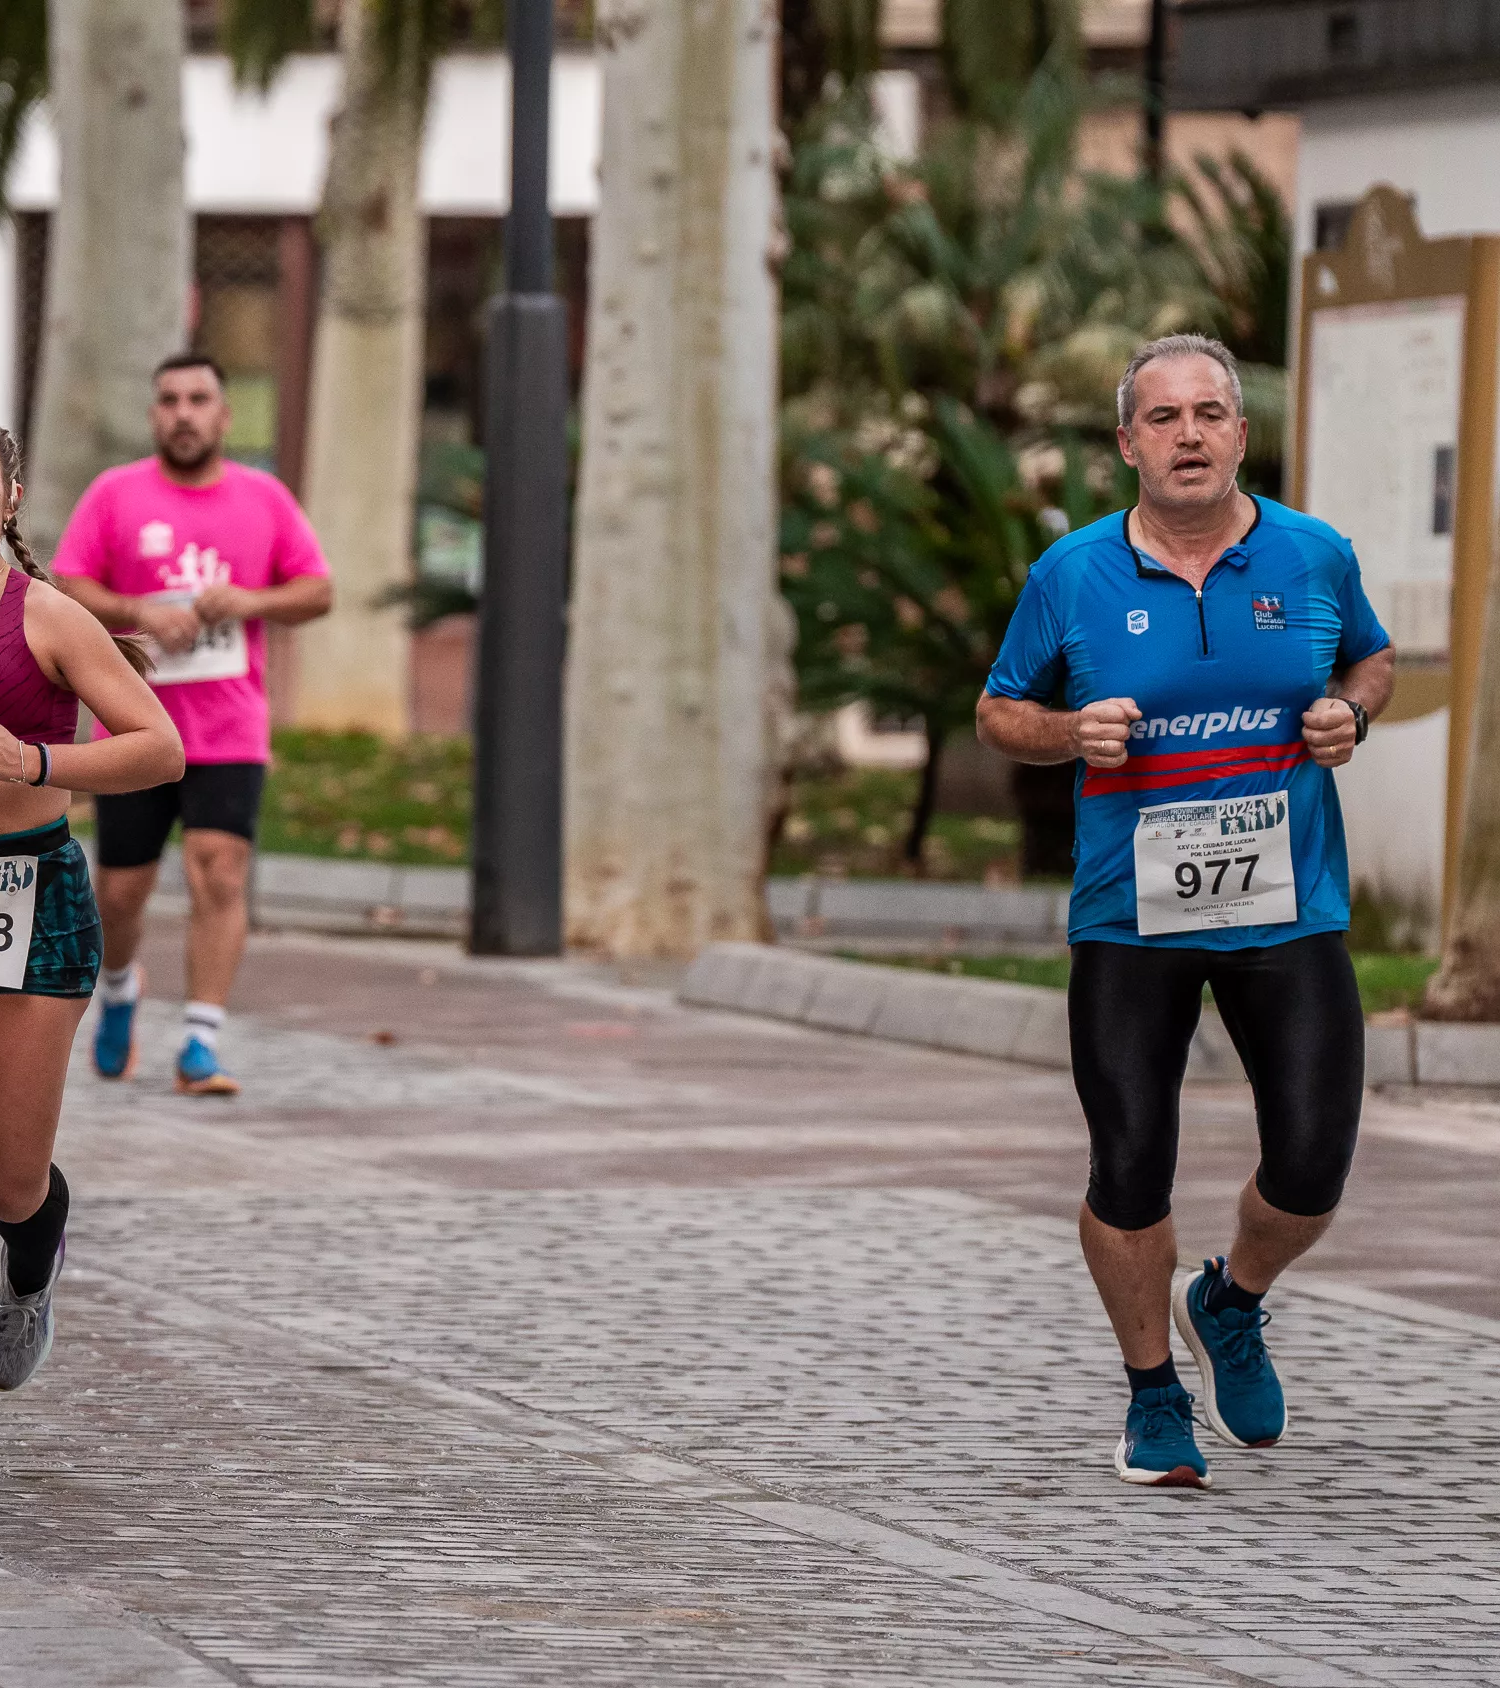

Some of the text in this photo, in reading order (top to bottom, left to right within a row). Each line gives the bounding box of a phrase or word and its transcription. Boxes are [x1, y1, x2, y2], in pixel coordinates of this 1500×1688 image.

[1254, 610, 1273, 618] Club
[1131, 622, 1145, 630] OVAL
[1256, 617, 1286, 625] Maratón
[1130, 706, 1282, 740] enerplus
[1169, 806, 1207, 816] PROVINCIAL
[1217, 801, 1256, 819] 2024
[1176, 812, 1217, 822] POPULARES
[1176, 843, 1190, 851] XXV
[1202, 841, 1225, 849] CIUDAD
[1233, 837, 1257, 845] LUCENA
[1212, 847, 1243, 855] IGUALDAD
[1174, 853, 1260, 899] 977
[1225, 900, 1255, 908] PAREDES
